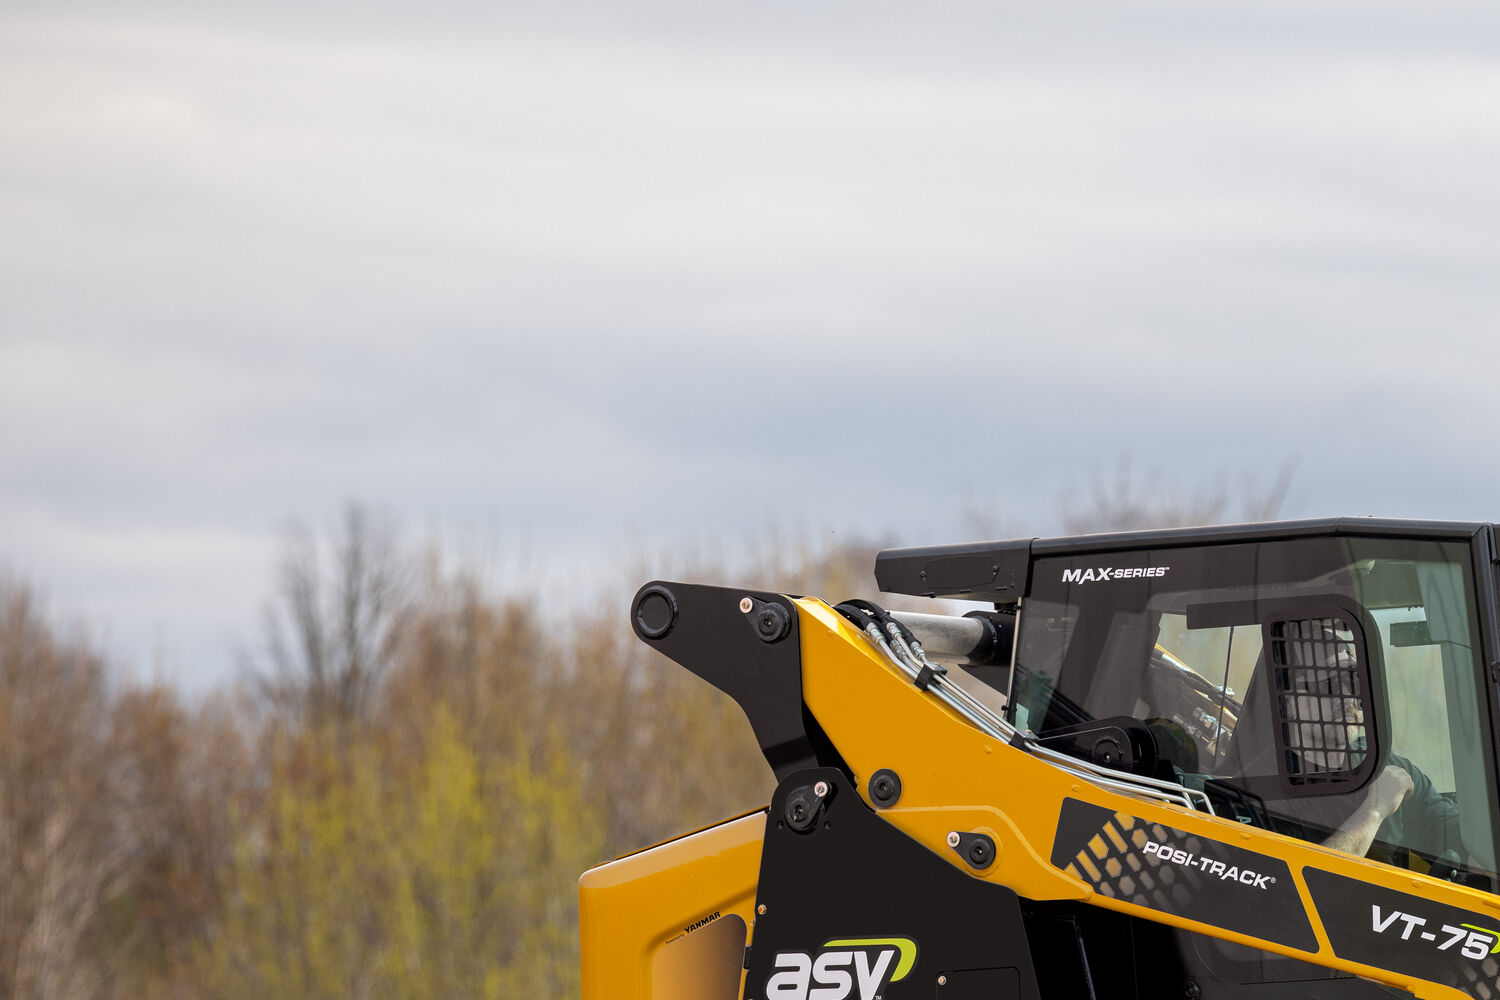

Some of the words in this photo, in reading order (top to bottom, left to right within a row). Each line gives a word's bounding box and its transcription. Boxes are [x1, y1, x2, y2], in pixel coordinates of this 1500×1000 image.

[1062, 567, 1166, 584] MAX-SERIES
[1142, 841, 1271, 889] POSI-TRACK
[684, 911, 720, 933] YANMAR
[1372, 904, 1494, 960] VT-75
